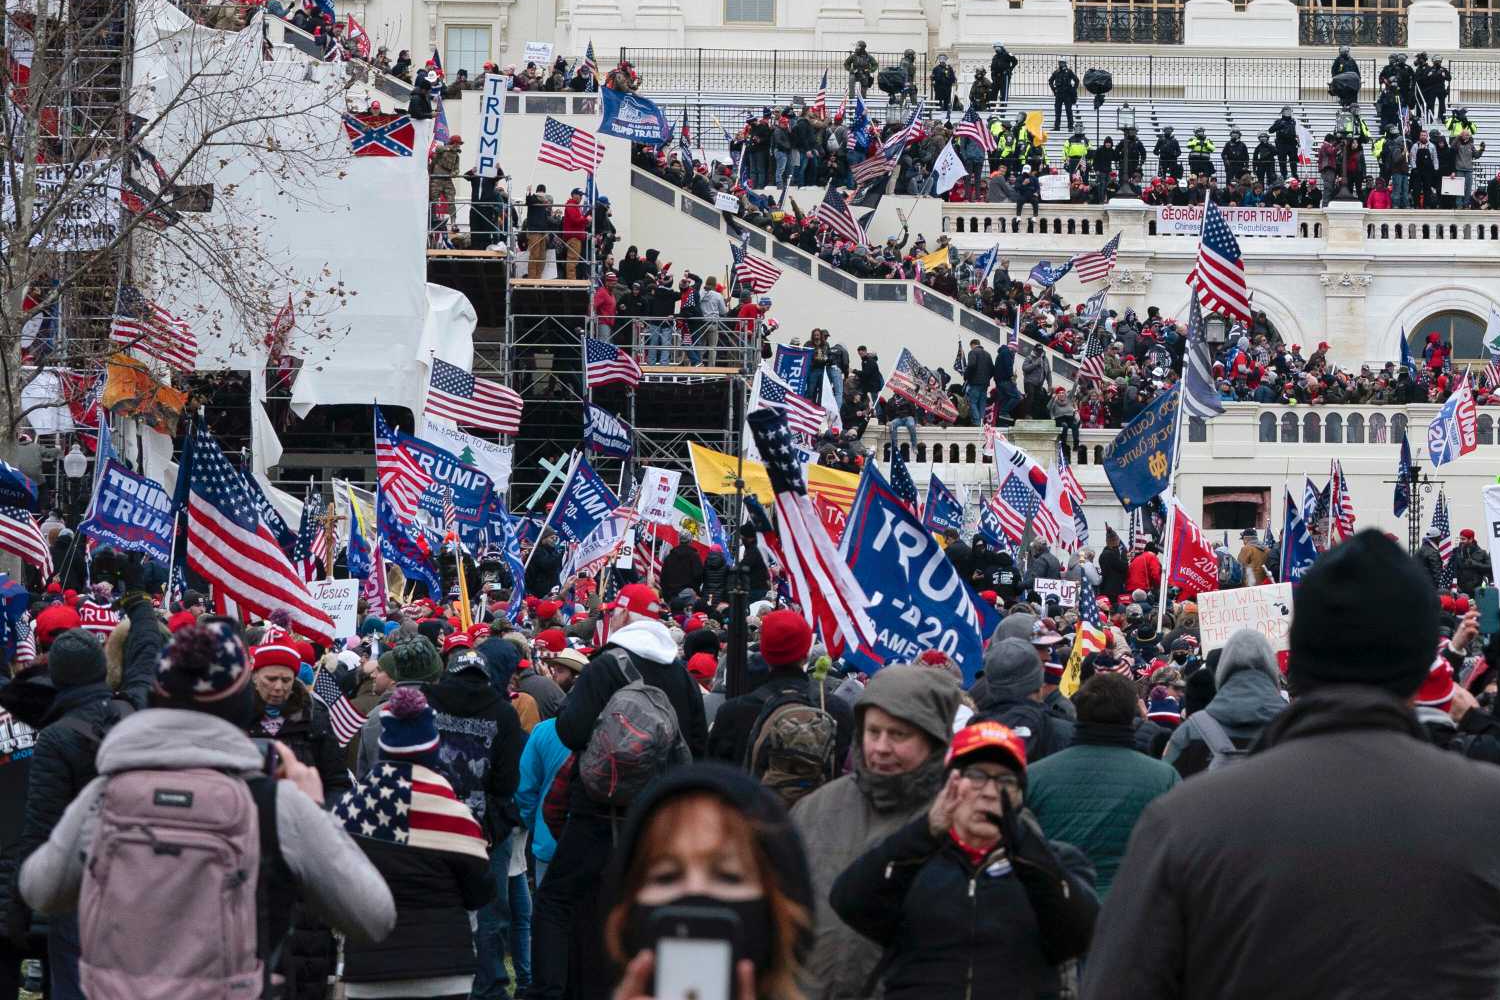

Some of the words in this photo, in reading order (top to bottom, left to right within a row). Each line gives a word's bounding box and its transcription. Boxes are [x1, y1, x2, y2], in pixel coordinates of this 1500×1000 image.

[479, 78, 503, 174] TRUMP
[1161, 208, 1204, 222] GEORGIA
[1237, 210, 1257, 222] FOR
[1261, 210, 1293, 223] TRUMP
[1238, 223, 1280, 233] Republicans
[427, 420, 439, 432] AN
[440, 425, 470, 443] APPEAL
[472, 436, 482, 448] TO
[405, 447, 488, 491] TRUMP
[314, 583, 350, 601] Jesus
[1036, 579, 1058, 591] Lock
[1200, 607, 1249, 626] REJOICE
[1256, 604, 1269, 618] IN
